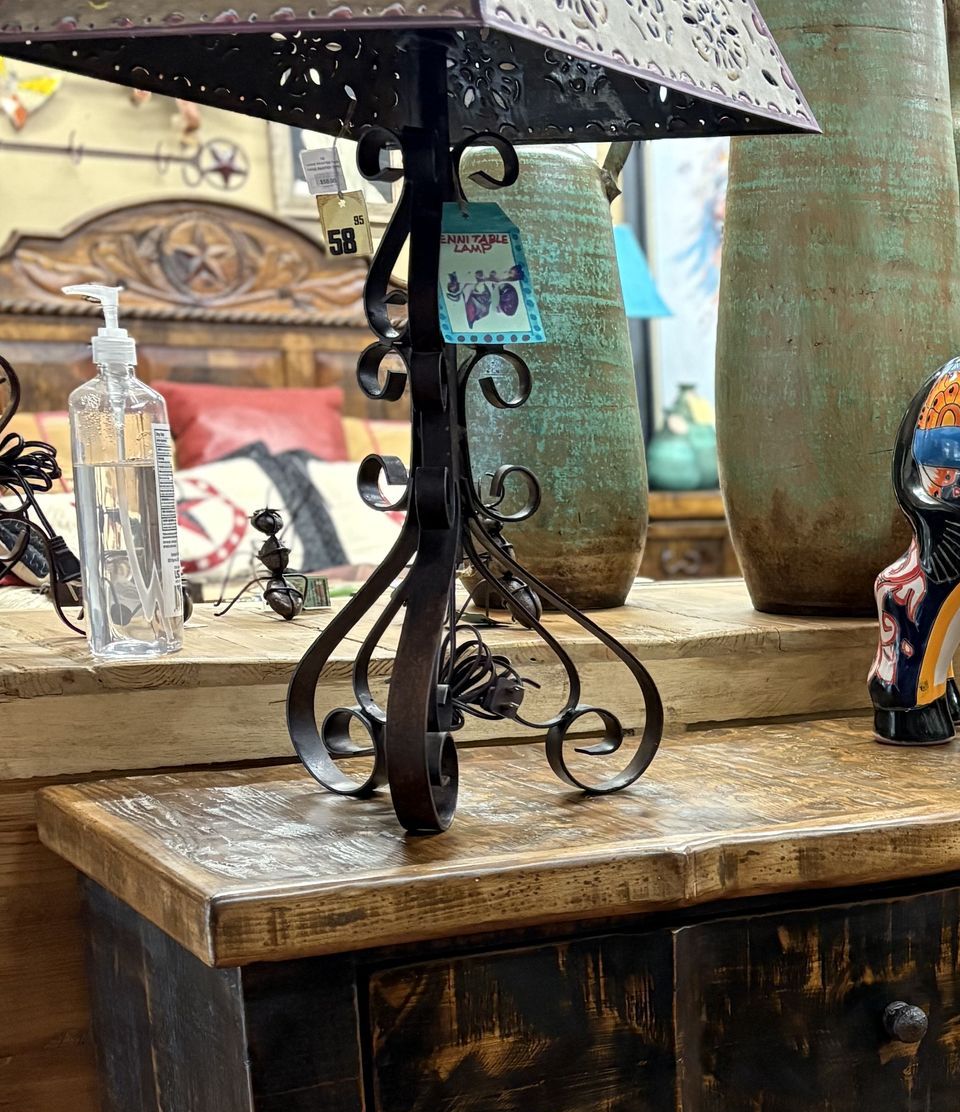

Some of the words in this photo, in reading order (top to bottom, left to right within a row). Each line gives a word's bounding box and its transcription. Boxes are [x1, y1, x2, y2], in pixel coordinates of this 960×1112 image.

[327, 227, 357, 256] 58
[353, 215, 364, 226] 95
[440, 234, 469, 244] ENNI
[471, 234, 509, 244] TABLE
[454, 244, 492, 254] LAMP
